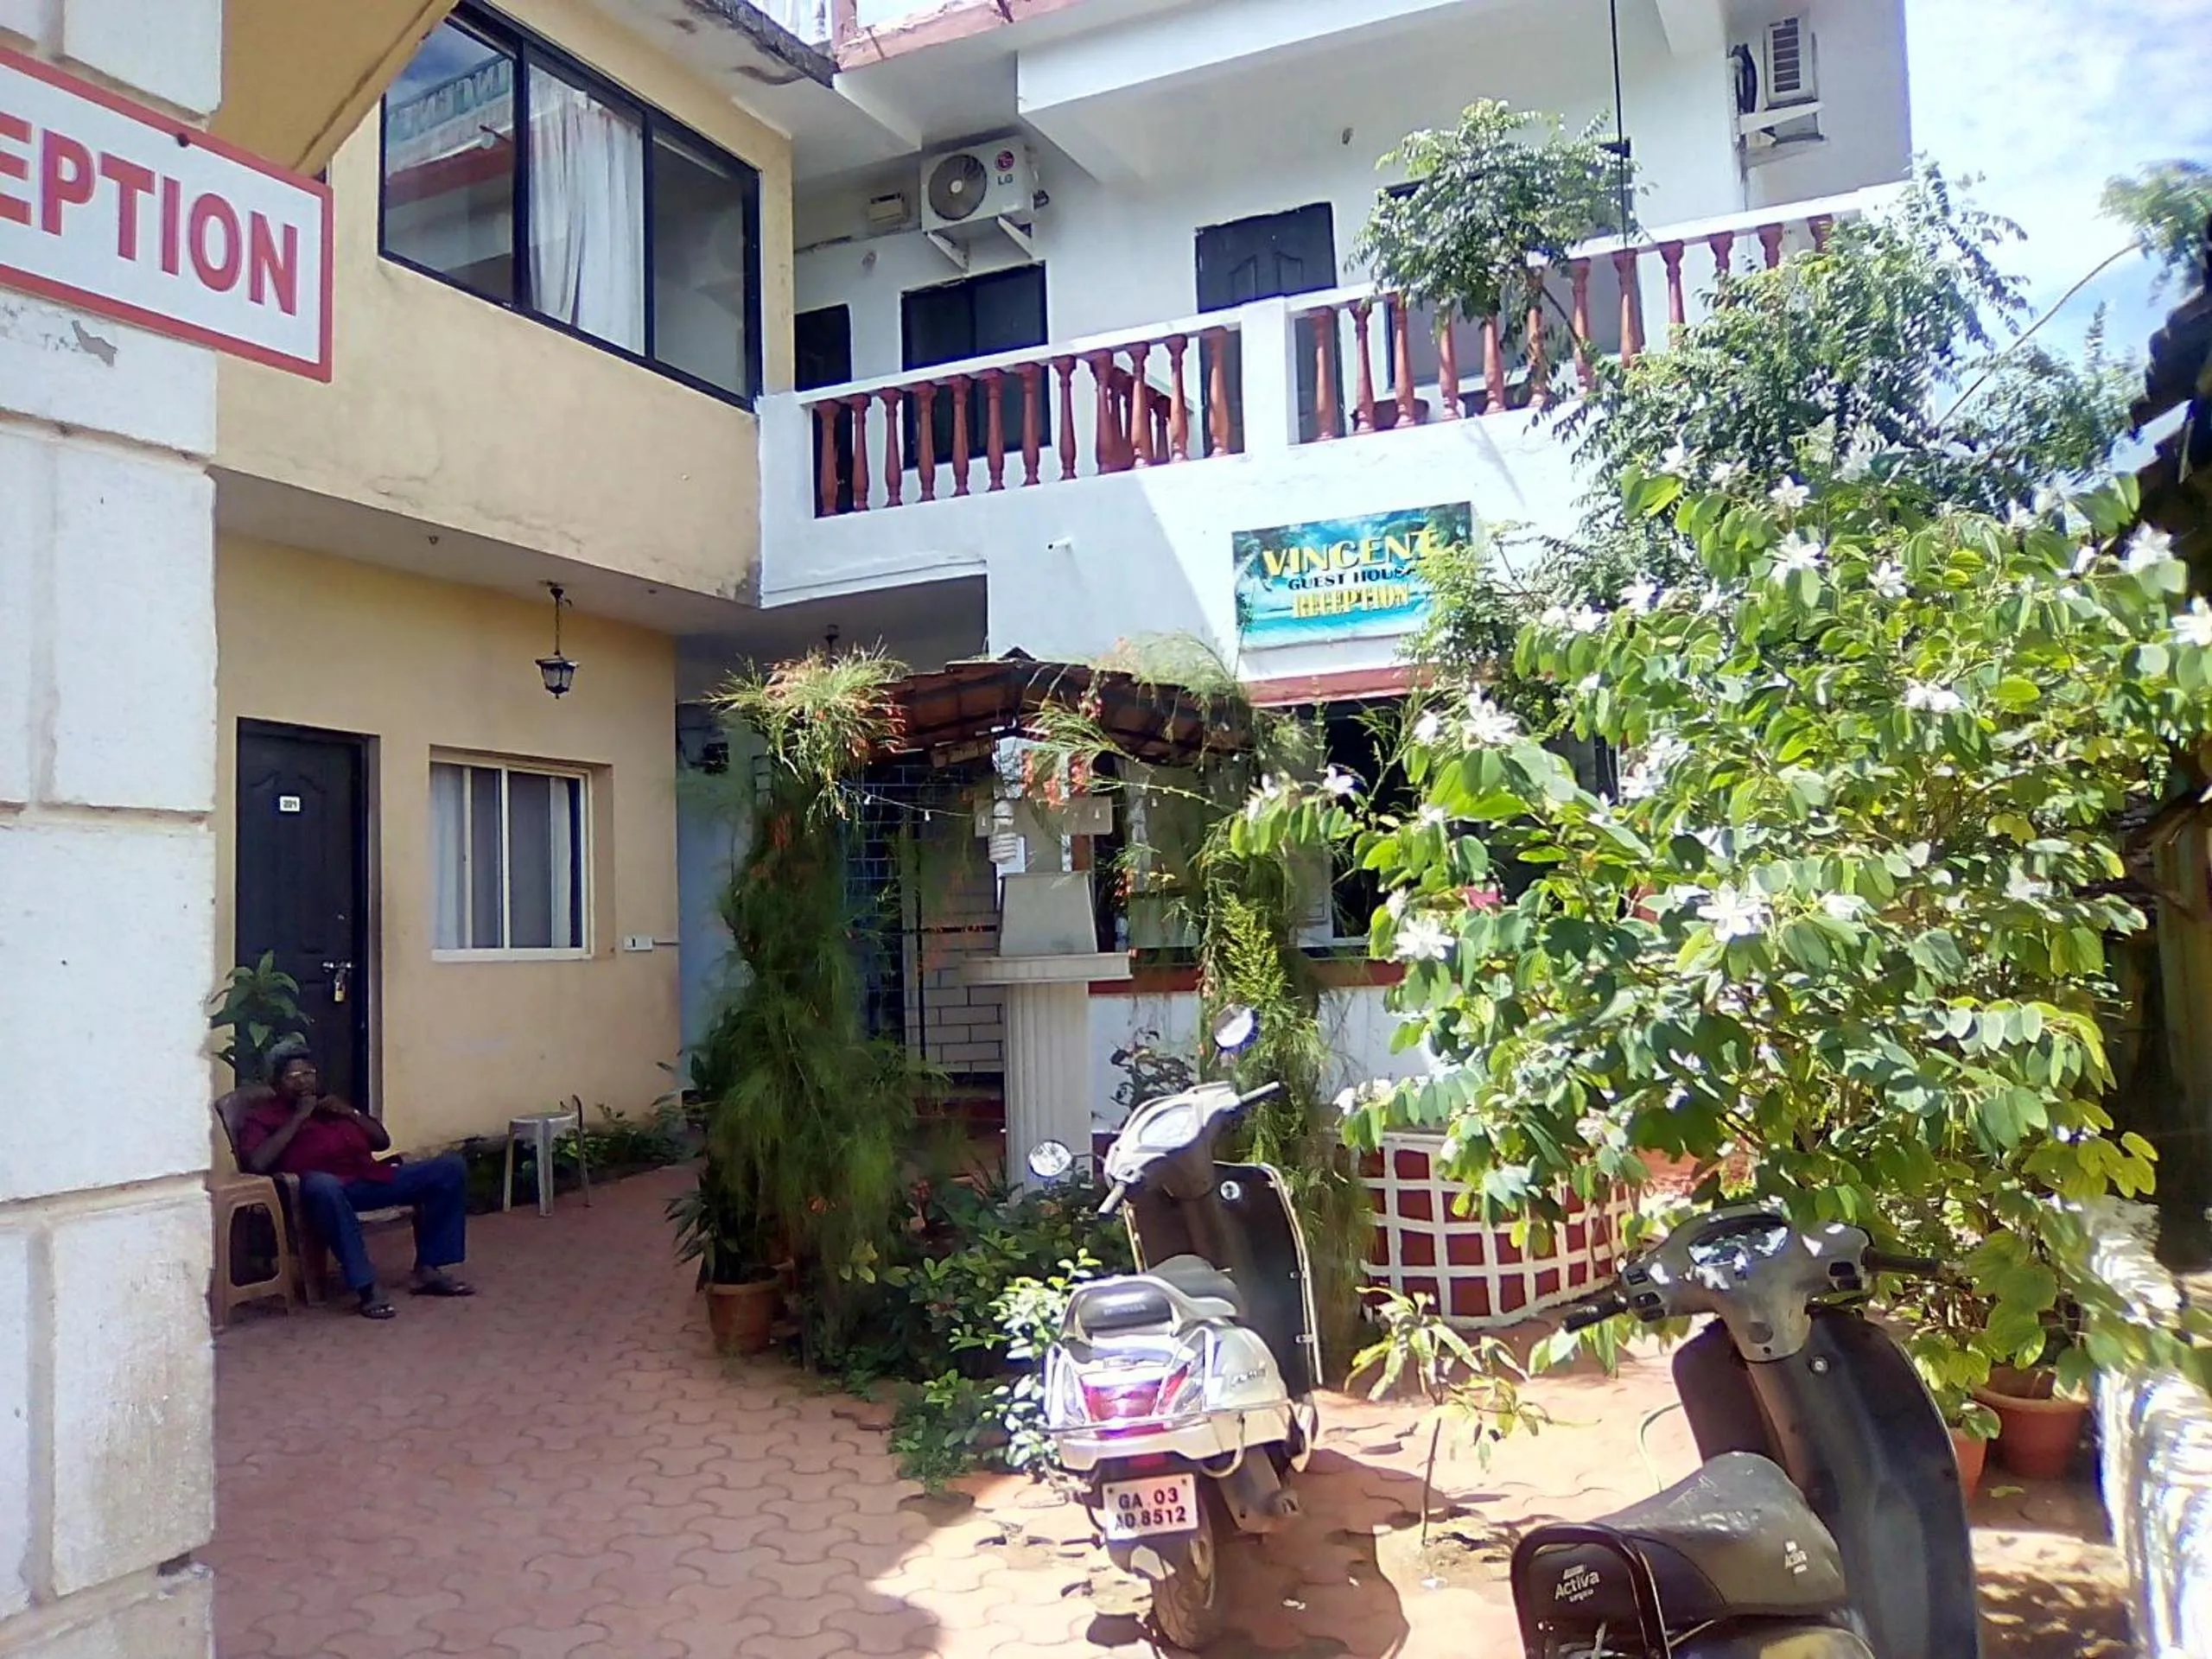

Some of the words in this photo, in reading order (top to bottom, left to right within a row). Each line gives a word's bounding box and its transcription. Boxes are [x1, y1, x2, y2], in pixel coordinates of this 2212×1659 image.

[997, 174, 1014, 186] LG
[0, 111, 297, 316] EPTION
[1262, 530, 1436, 578] VINCENT
[1287, 573, 1345, 591] GUEST
[1118, 1493, 1143, 1510] GA
[1154, 1487, 1179, 1505] 03
[1554, 1571, 1600, 1601] Activa
